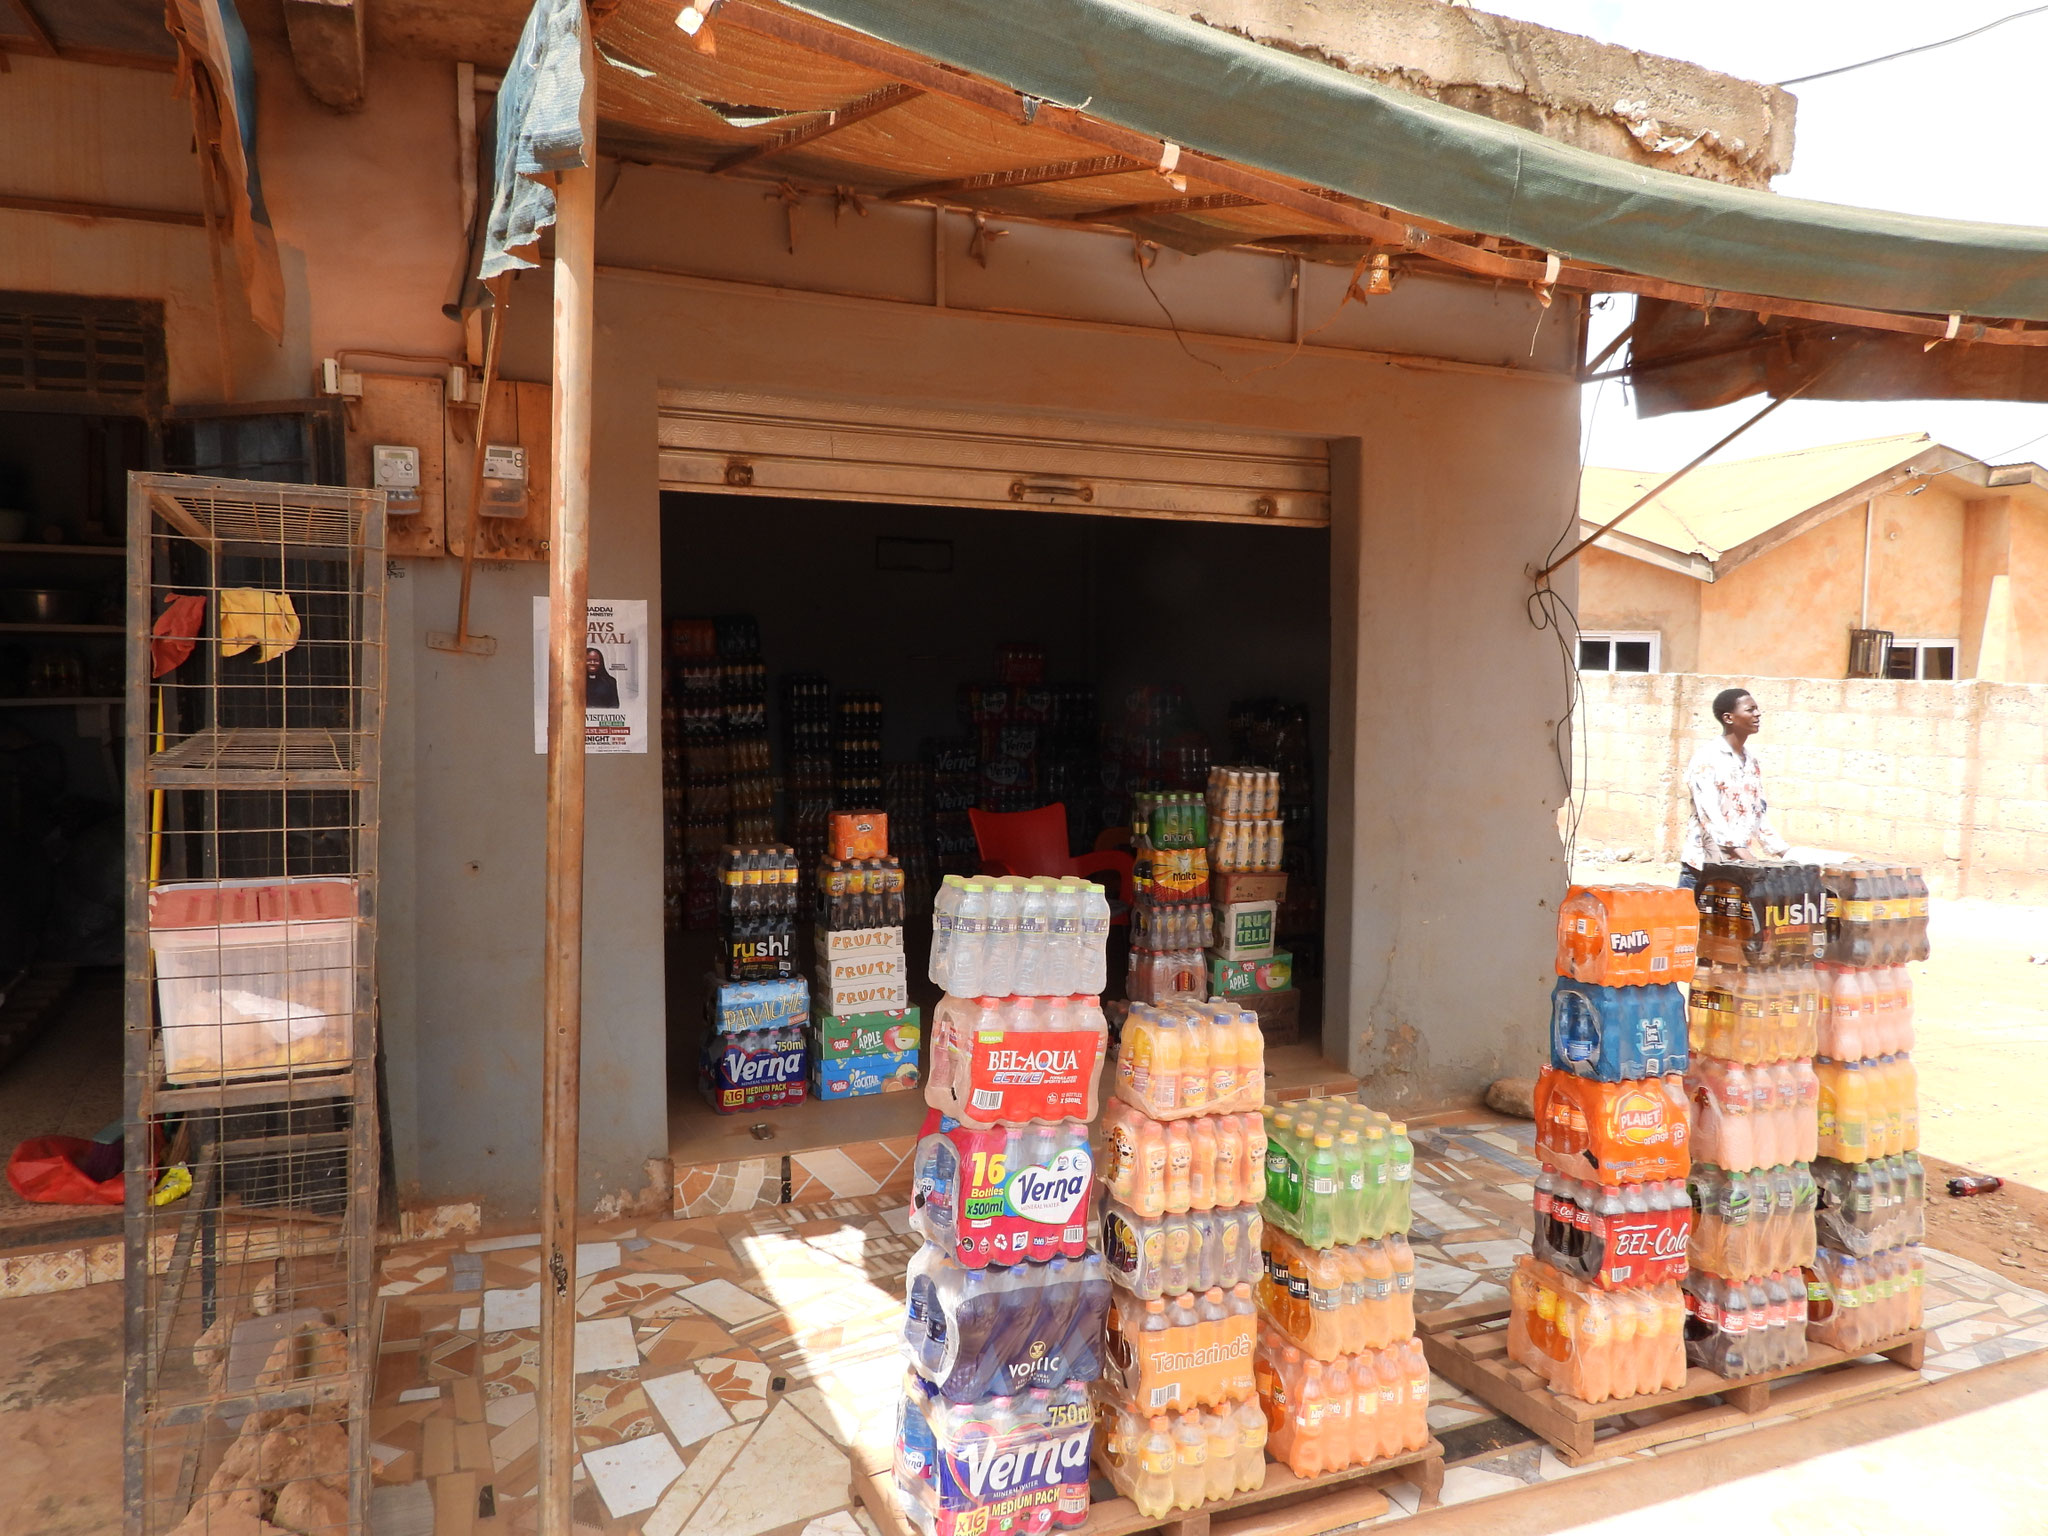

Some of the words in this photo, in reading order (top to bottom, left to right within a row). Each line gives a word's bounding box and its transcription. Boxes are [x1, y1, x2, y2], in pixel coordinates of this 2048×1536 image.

[1003, 736, 1033, 754] Verna
[936, 752, 976, 771] Verna
[936, 791, 976, 810] Verna
[1172, 872, 1197, 882] Malta
[1766, 893, 1826, 927] rush!
[1237, 914, 1263, 929] FRU
[831, 932, 894, 949] FRUITY
[1236, 928, 1271, 943] TELLI
[1610, 930, 1650, 951] FANTA
[733, 935, 789, 957] rush!
[834, 961, 896, 978] FRUITY
[1229, 973, 1250, 990] APPLE
[836, 987, 897, 1004] FRUITY
[723, 992, 805, 1032] PANACHE
[776, 1039, 805, 1052] 750ml
[859, 1031, 882, 1049] APPLE
[723, 1053, 802, 1084] Verna
[745, 1085, 770, 1096] MEDIUM
[771, 1083, 787, 1092] PACK
[1620, 1109, 1661, 1129] PLANET
[1643, 1130, 1669, 1145] orange
[1673, 1129, 1684, 1141] 10
[971, 1152, 1008, 1187] 16
[971, 1187, 1004, 1198] Bottles
[1017, 1172, 1084, 1206] Verna
[967, 1201, 1003, 1216] x500ml
[1021, 1203, 1044, 1211] MINERAL
[957, 1431, 1091, 1497] Verna
[993, 1487, 1019, 1499] MINERAL
[1018, 1479, 1039, 1491] WATER
[991, 1495, 1033, 1517] MEDIUM
[1035, 1486, 1060, 1506] PACK
[958, 1509, 985, 1533] x16
